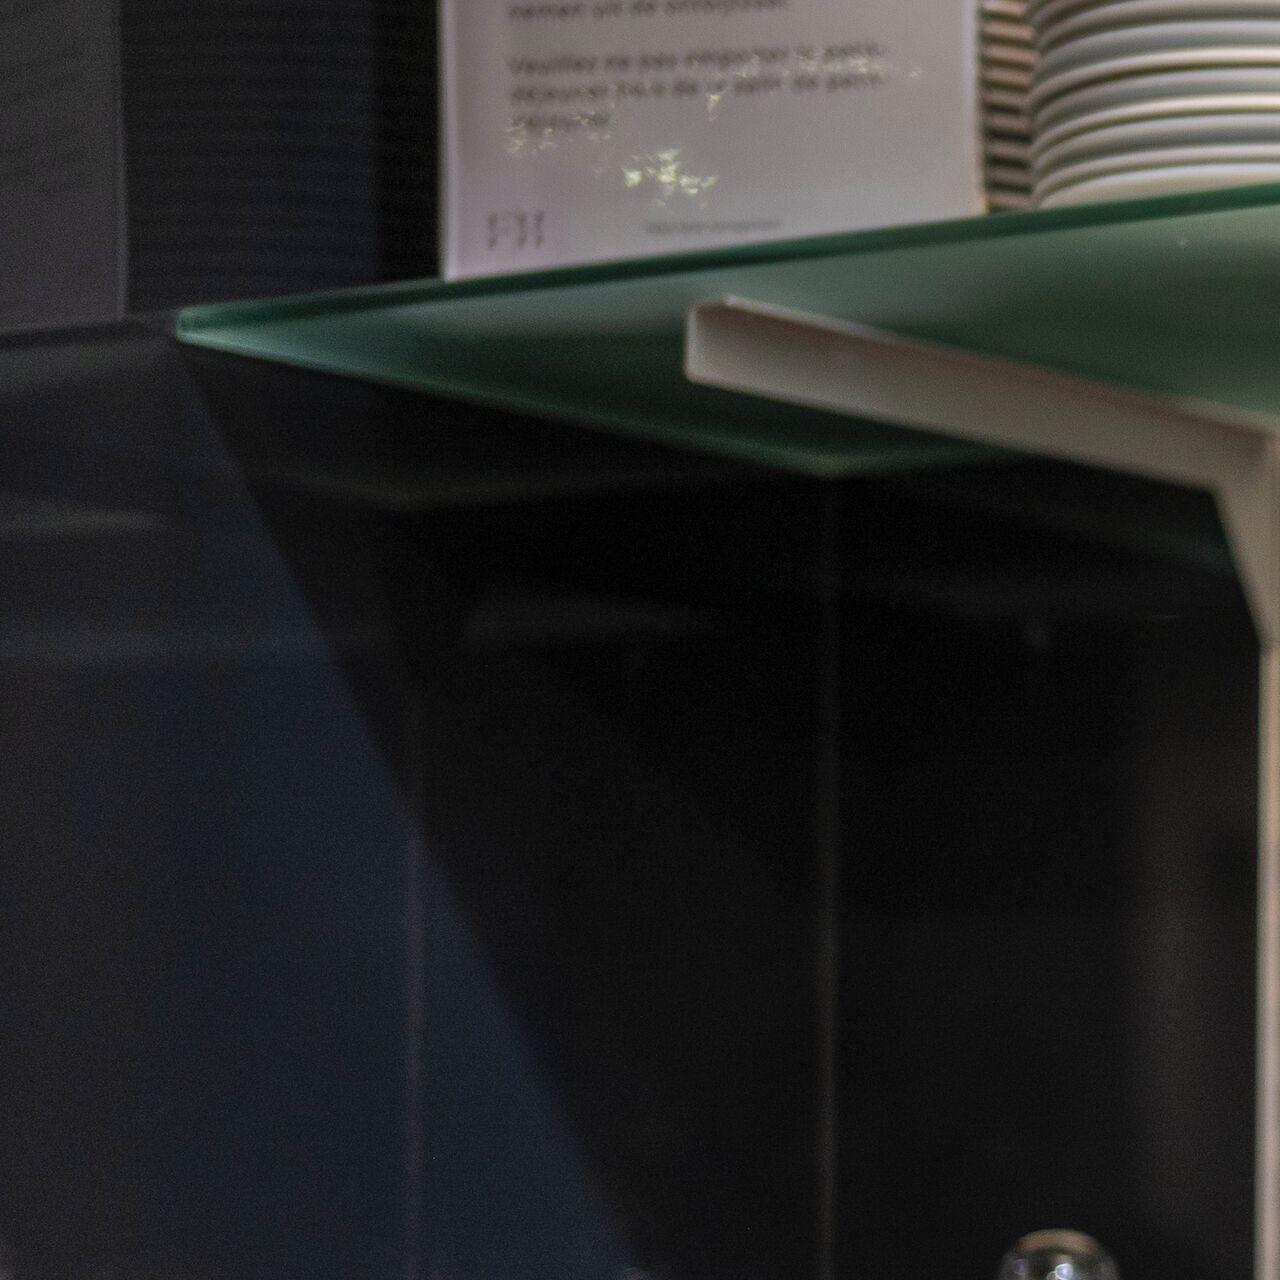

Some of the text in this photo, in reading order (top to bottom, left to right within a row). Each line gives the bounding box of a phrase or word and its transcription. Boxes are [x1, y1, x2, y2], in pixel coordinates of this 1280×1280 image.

[506, 53, 597, 75] Veuillez
[605, 55, 630, 71] ne
[640, 54, 677, 73] pas
